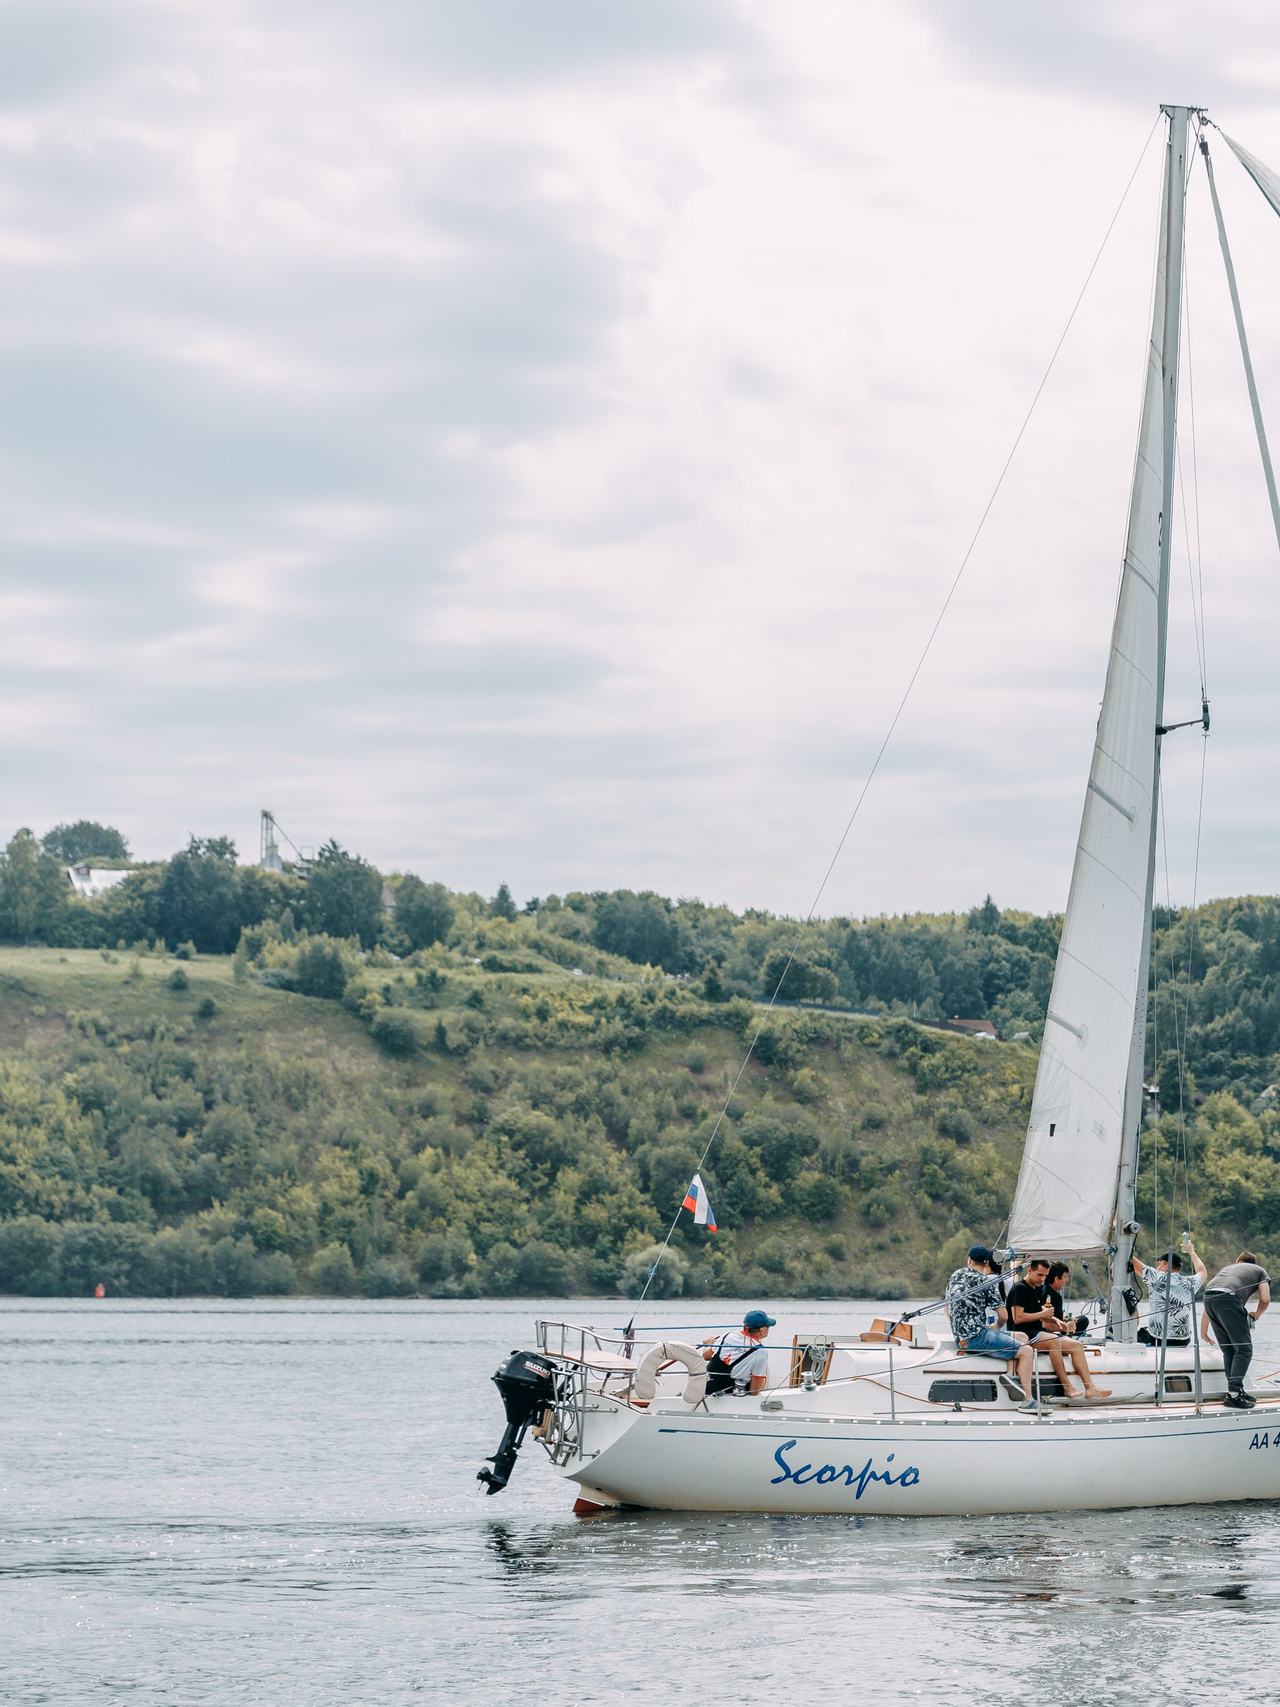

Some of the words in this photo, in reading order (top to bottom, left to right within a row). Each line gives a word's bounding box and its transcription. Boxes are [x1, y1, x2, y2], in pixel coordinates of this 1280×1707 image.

[525, 1360, 551, 1376] SUZUKI
[1249, 1433, 1269, 1450] AA
[771, 1439, 920, 1500] Scorpio
